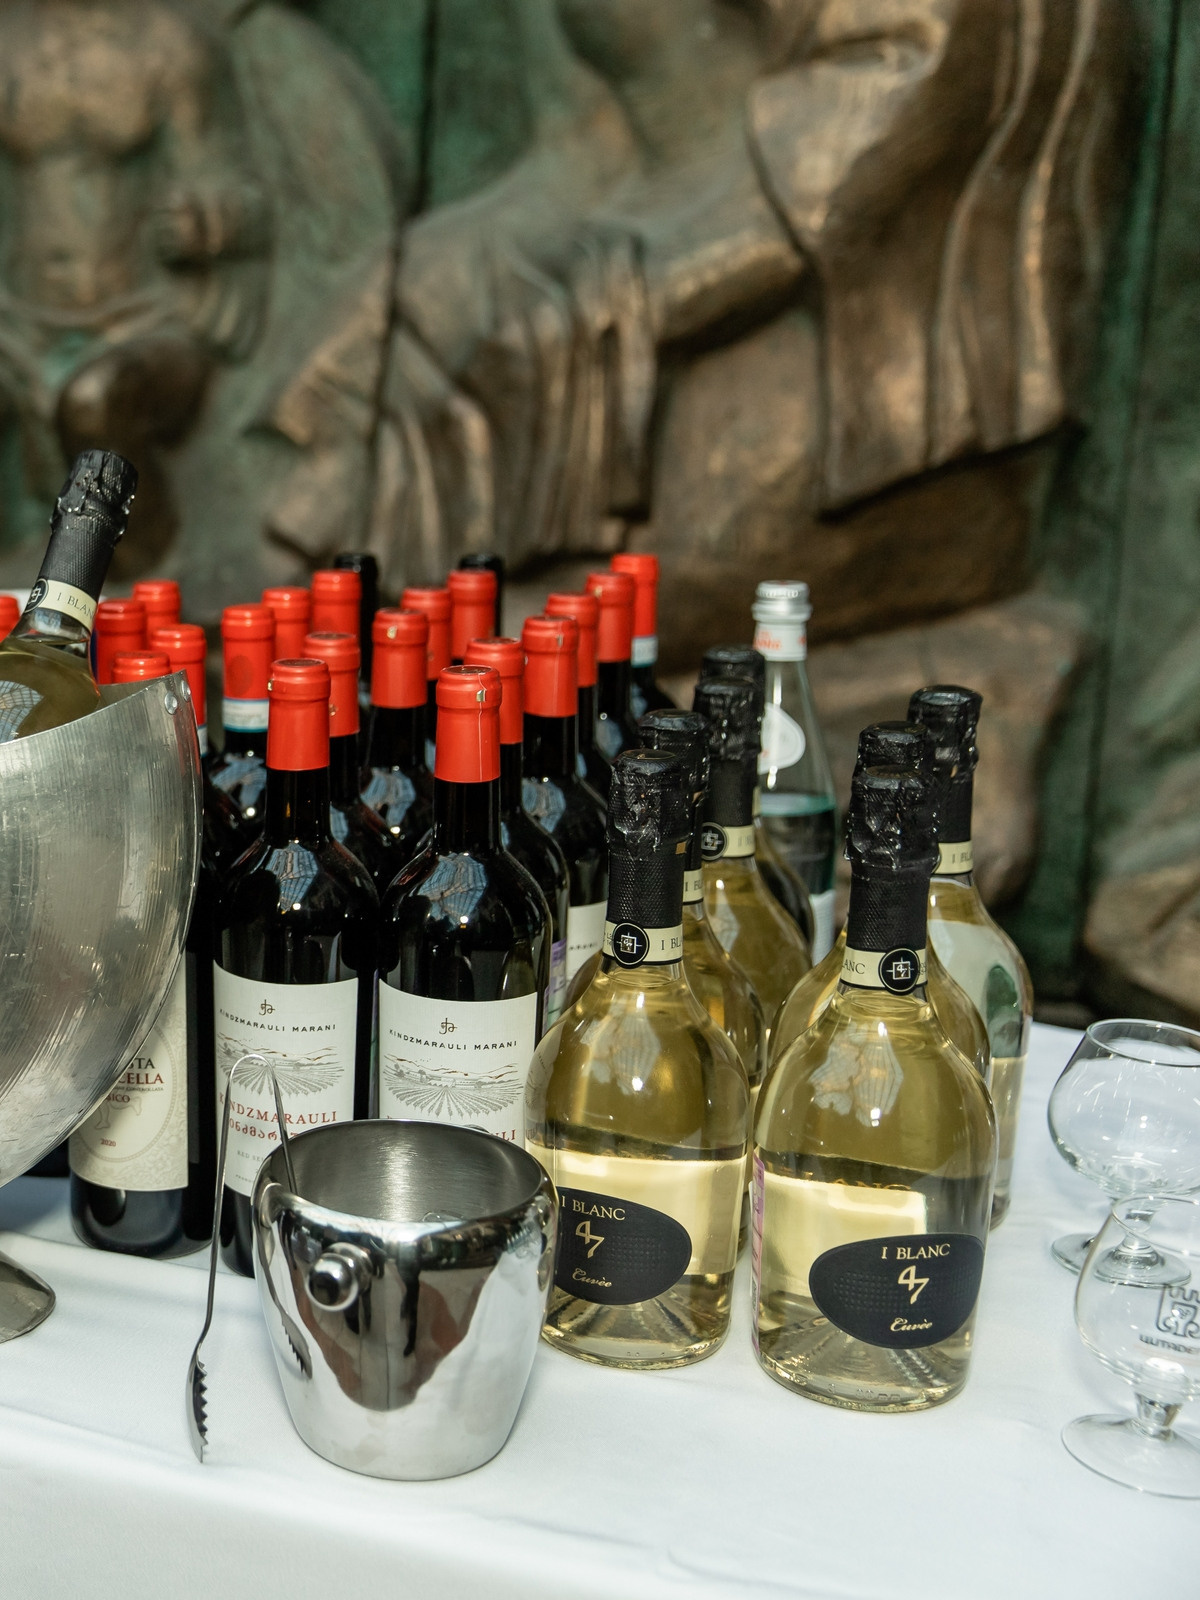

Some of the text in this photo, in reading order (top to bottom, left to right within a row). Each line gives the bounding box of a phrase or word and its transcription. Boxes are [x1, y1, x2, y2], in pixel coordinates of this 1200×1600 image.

[67, 595, 95, 620] BLAN
[841, 959, 866, 975] ANC
[219, 1008, 336, 1033] KINDZMARAULI MARANI
[389, 1029, 517, 1051] KINDZMARAULI MARANI
[219, 1092, 337, 1125] KNDZMARAULI
[561, 1195, 626, 1221] I BLANC
[575, 1220, 605, 1259] 47
[881, 1243, 951, 1260] I BLANC
[897, 1265, 930, 1305] 47
